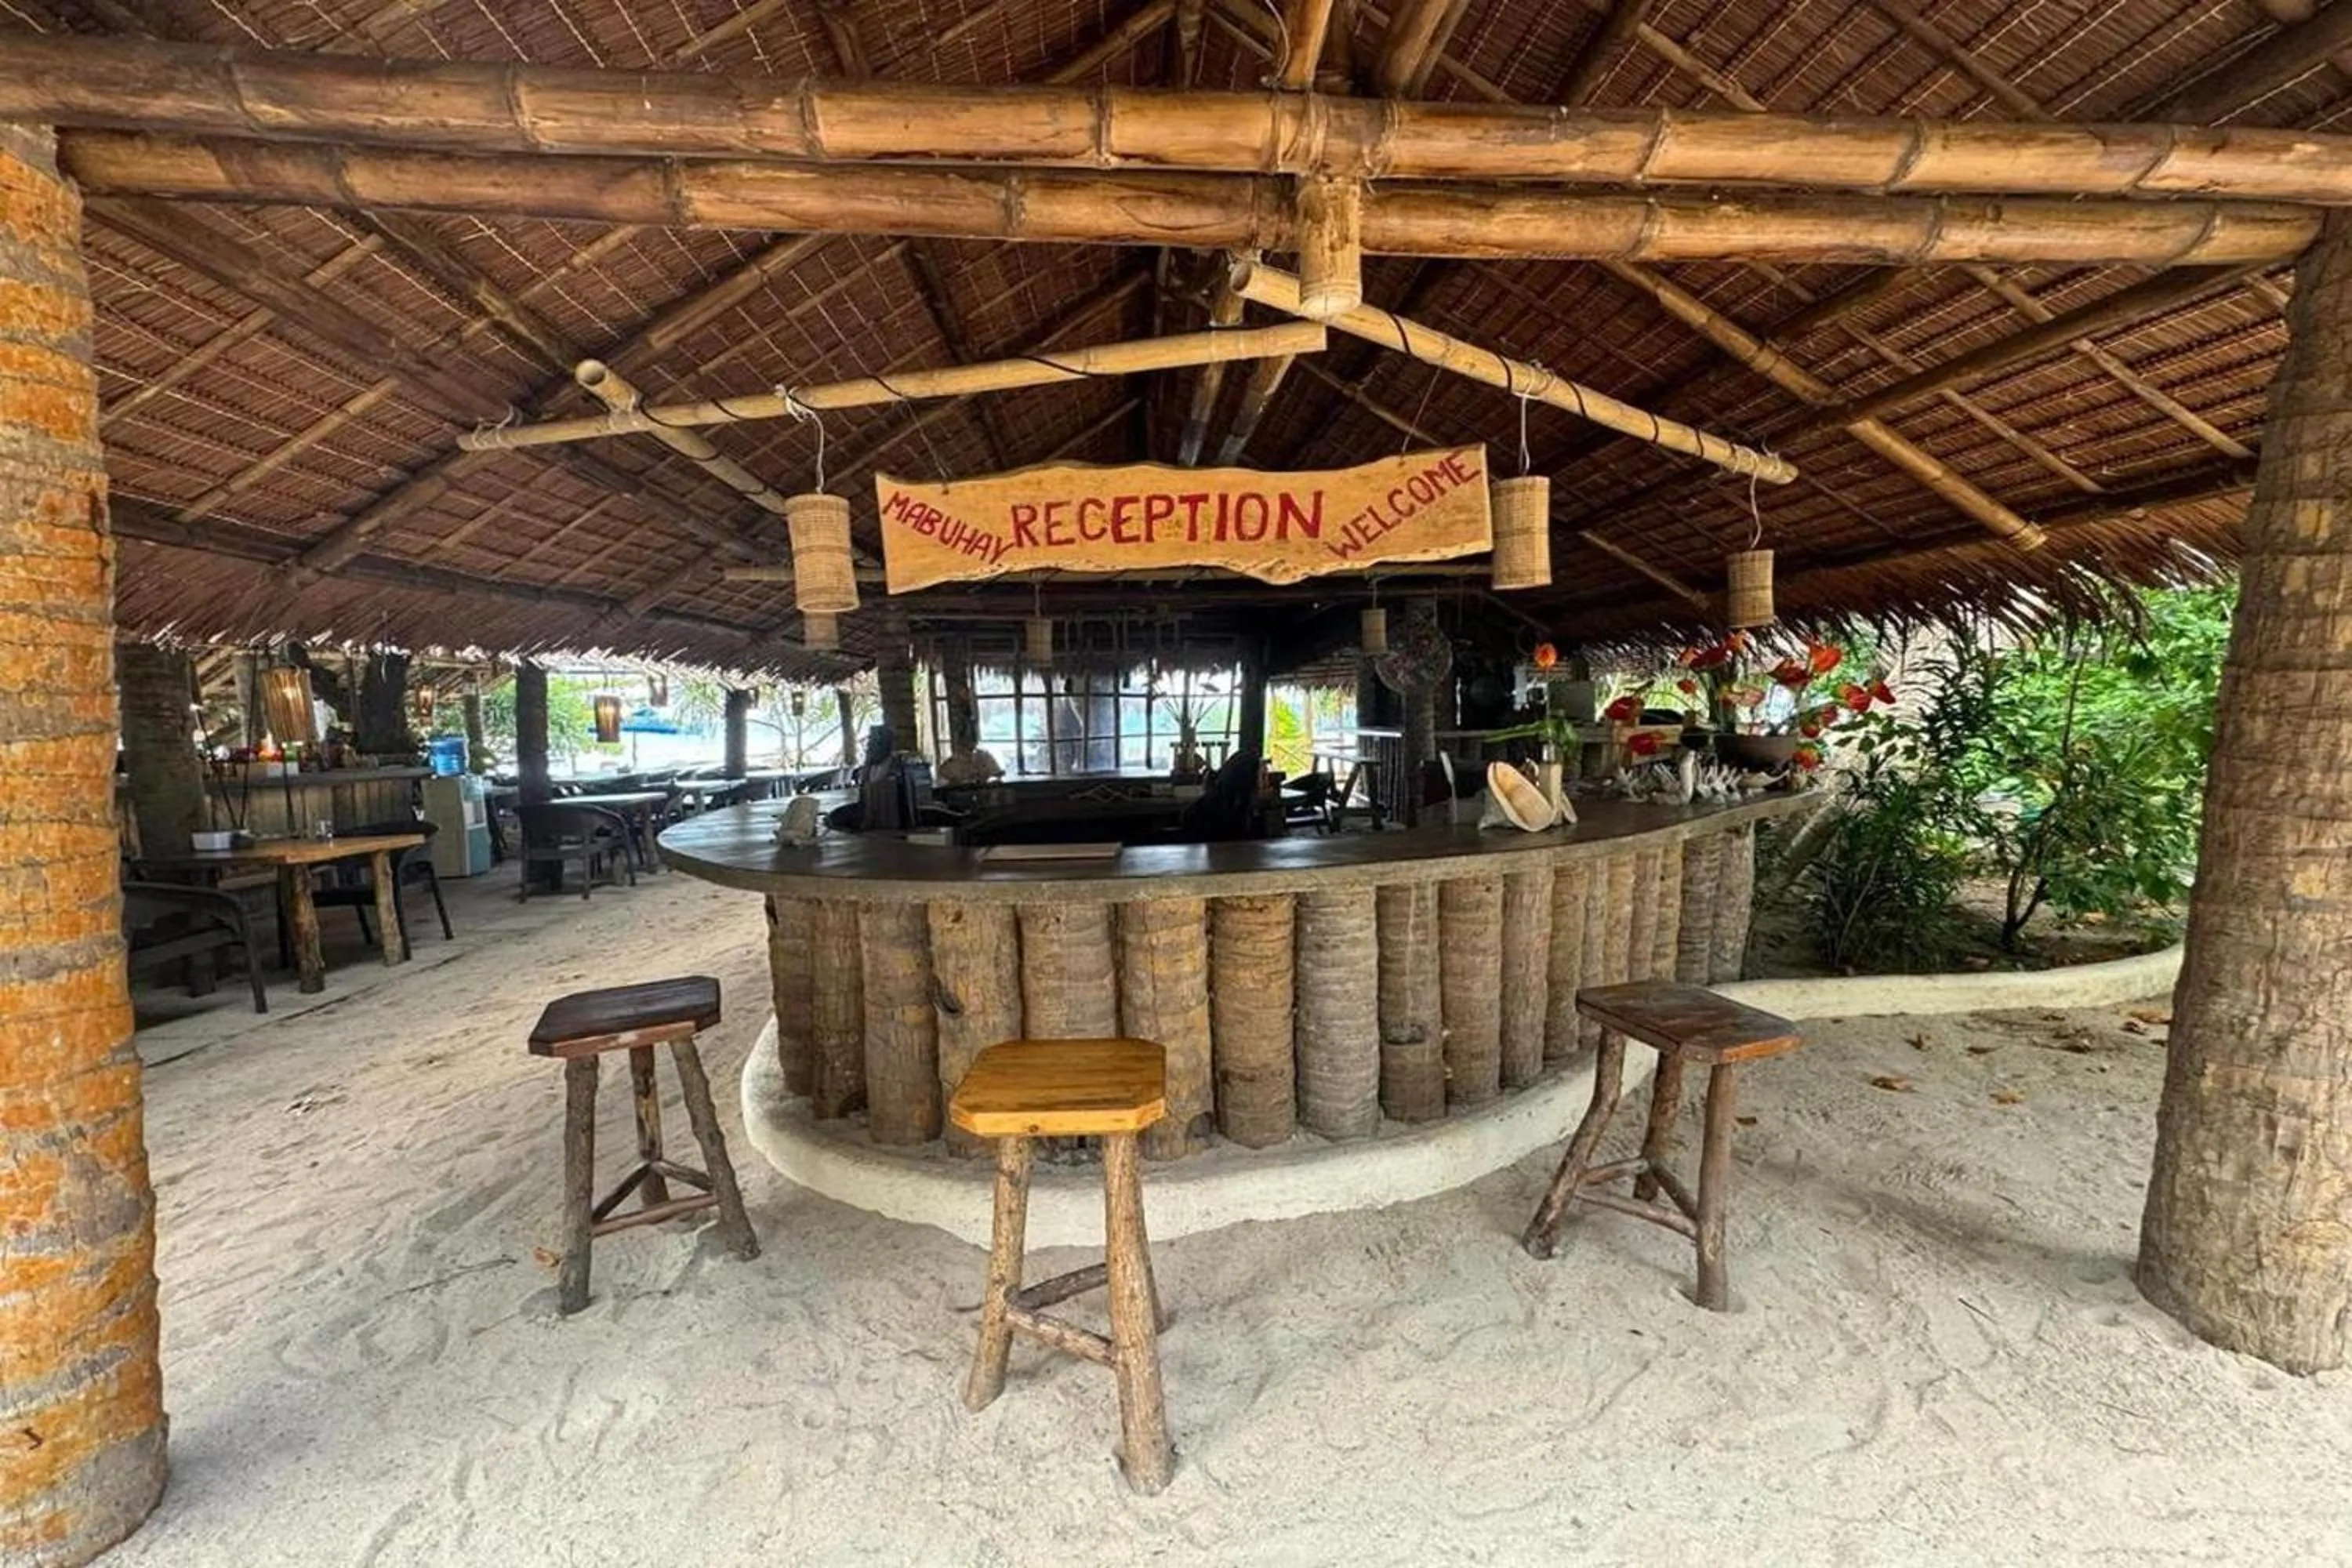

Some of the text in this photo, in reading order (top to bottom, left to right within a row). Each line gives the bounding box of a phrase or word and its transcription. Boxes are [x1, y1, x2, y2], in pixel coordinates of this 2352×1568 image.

[884, 452, 1480, 563] MABUHAY RECEPTION WELCOME
